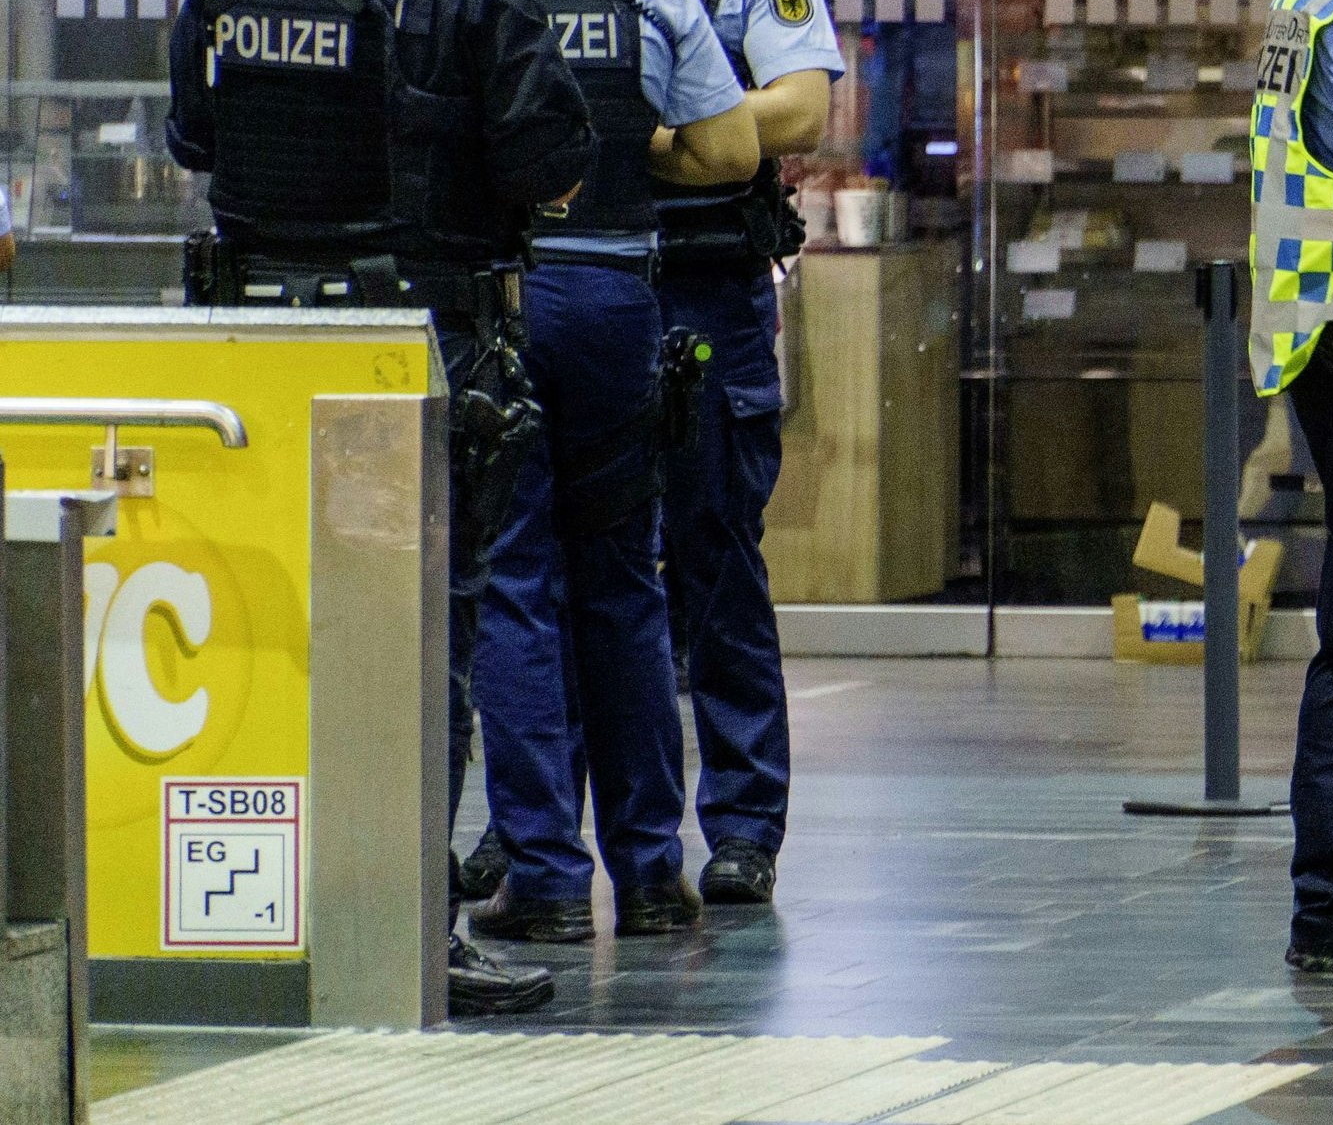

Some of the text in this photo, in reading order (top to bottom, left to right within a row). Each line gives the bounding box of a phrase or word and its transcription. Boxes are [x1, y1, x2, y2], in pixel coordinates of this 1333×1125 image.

[215, 13, 348, 67] POLIZEI
[178, 789, 287, 816] T-SB08
[186, 840, 227, 864] EG
[254, 901, 277, 925] -1
